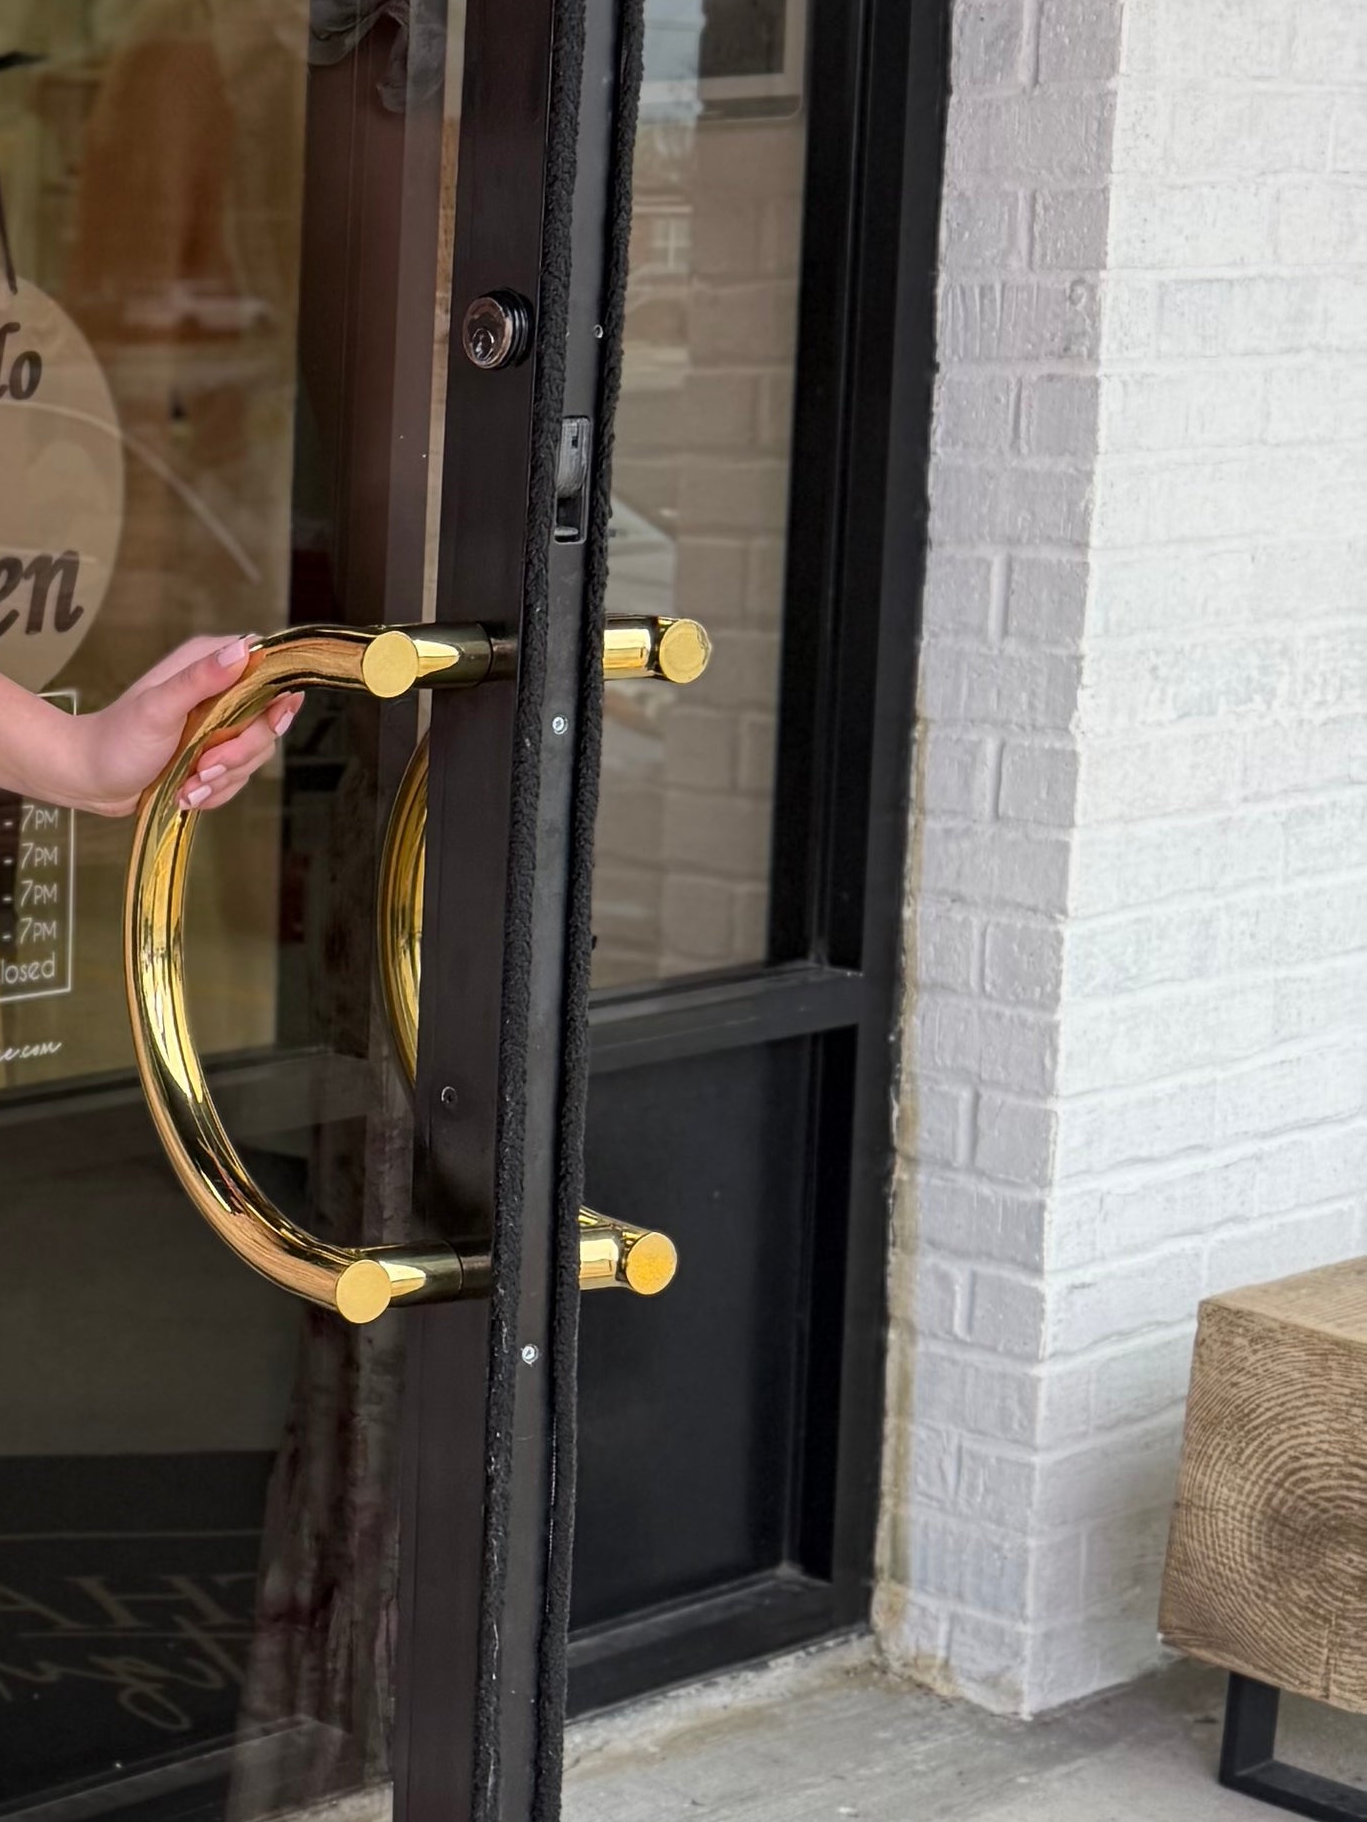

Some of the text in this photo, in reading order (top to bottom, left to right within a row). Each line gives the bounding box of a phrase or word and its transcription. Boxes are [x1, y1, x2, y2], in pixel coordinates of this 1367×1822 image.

[21, 804, 59, 833] 7PM
[21, 842, 59, 870] 7PM
[20, 879, 58, 908] 7PM
[19, 917, 57, 945] 7PM
